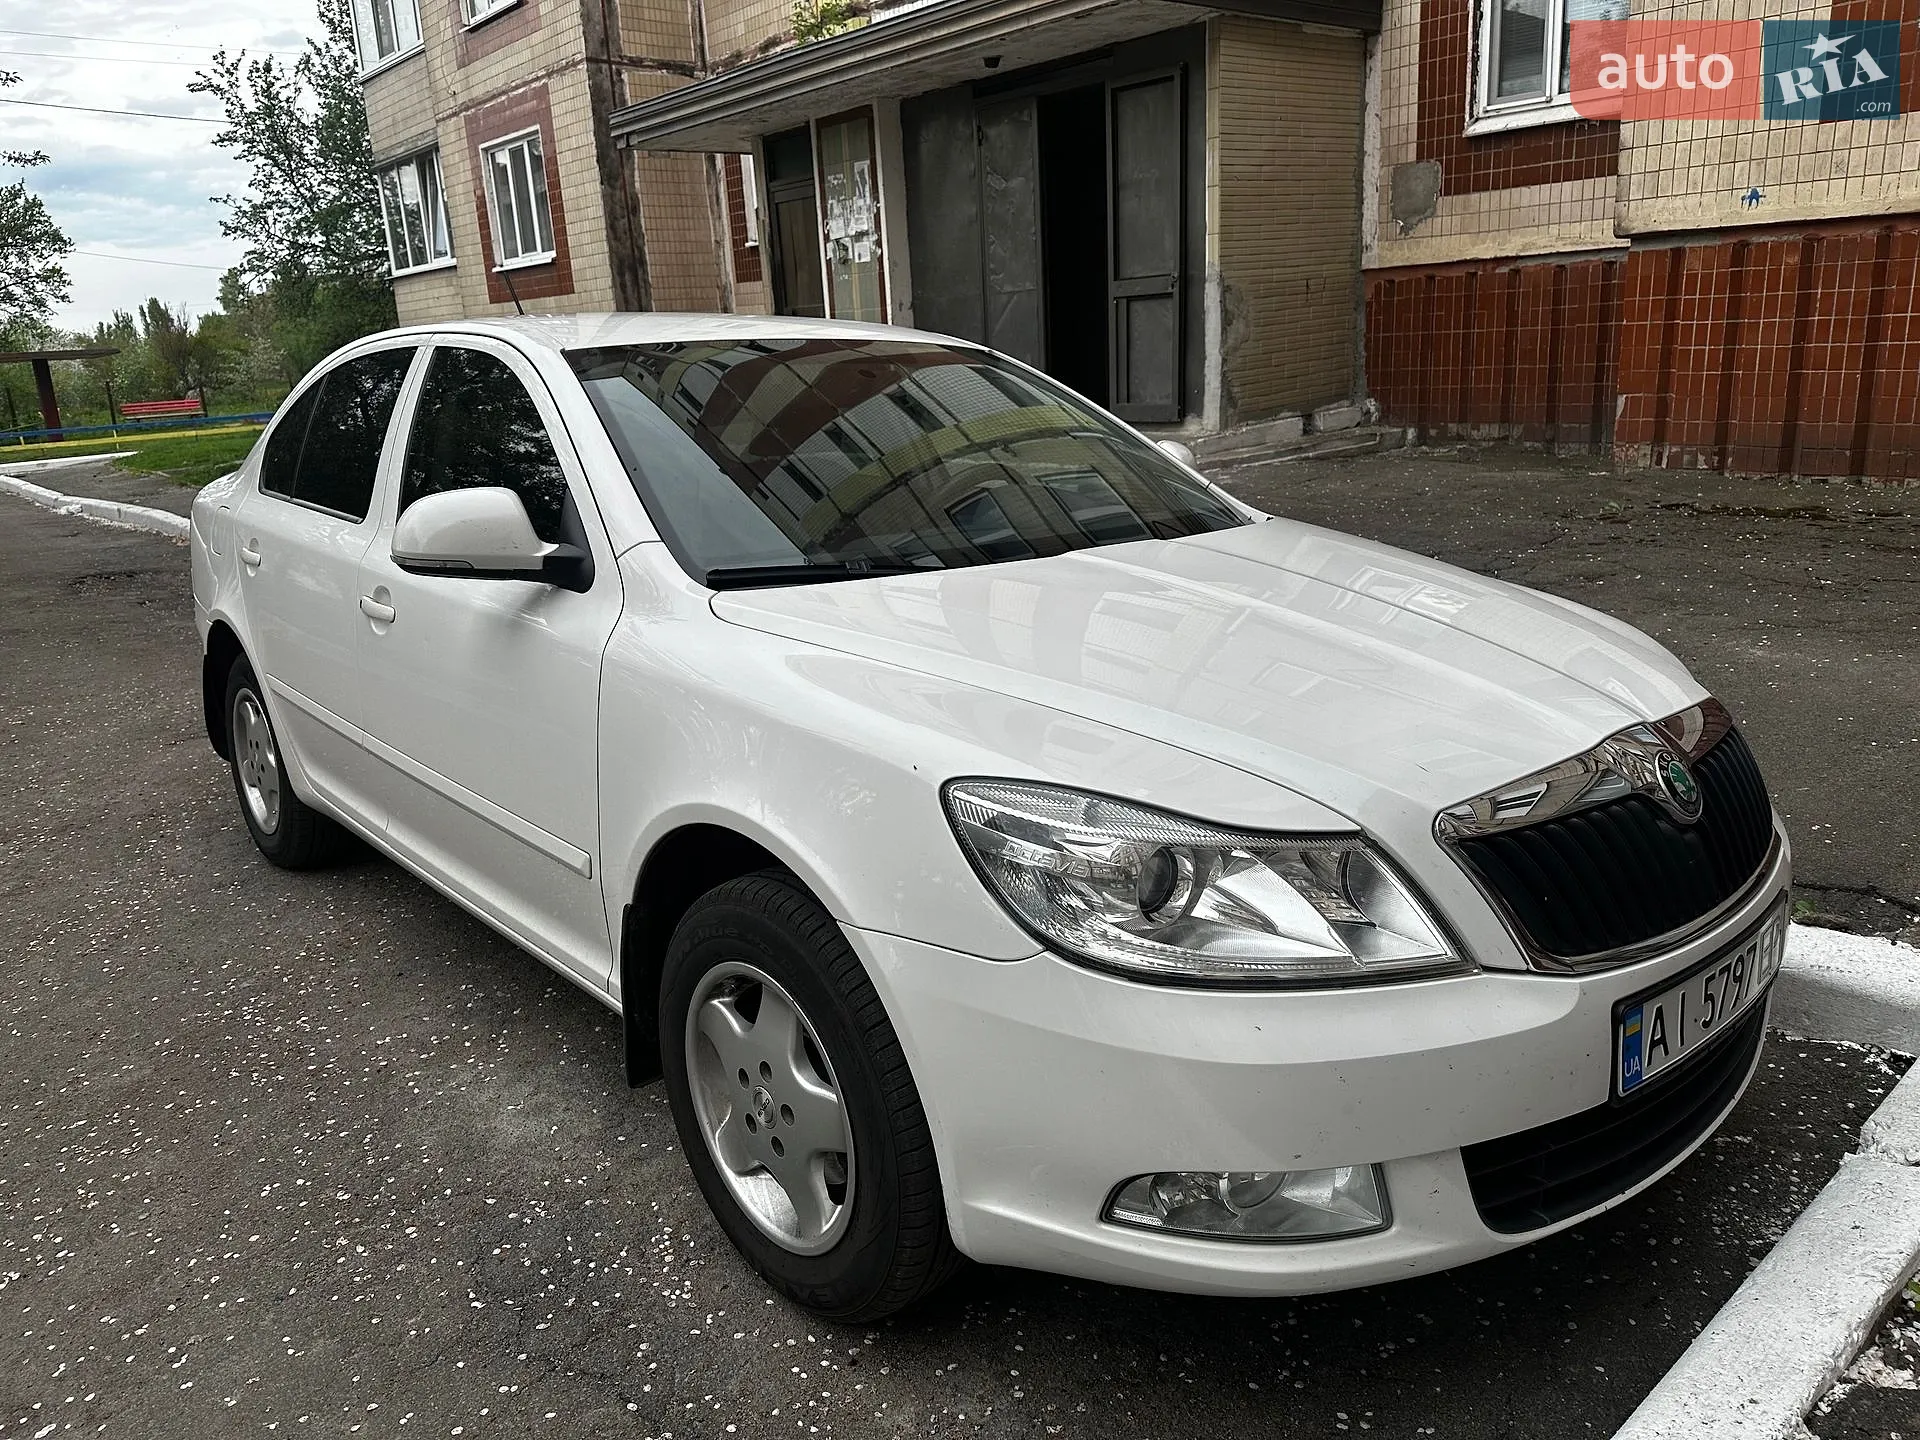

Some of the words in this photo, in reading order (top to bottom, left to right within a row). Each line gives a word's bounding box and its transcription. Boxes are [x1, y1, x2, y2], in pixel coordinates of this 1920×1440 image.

[1645, 990, 1686, 1068] AI
[1700, 941, 1758, 1030] 5797
[1624, 1058, 1641, 1077] UA
